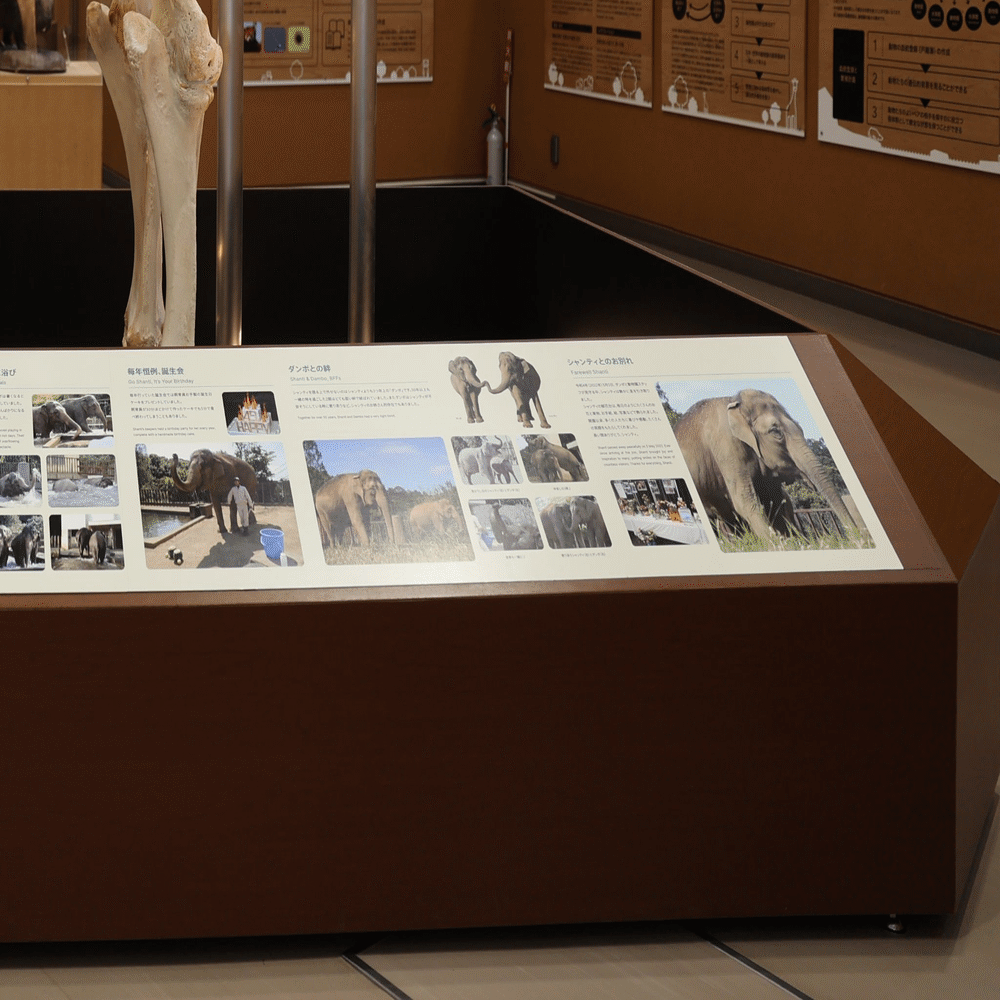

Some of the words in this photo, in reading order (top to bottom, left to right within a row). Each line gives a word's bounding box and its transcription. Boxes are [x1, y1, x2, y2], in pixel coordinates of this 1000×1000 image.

[735, 16, 740, 28] 3
[873, 39, 877, 52] 1
[872, 73, 878, 85] 2
[872, 105, 878, 118] 3
[567, 357, 634, 366] シャンティとのお別れ
[127, 367, 184, 376] 毎年恒例、誕生会
[288, 364, 331, 373] ダンボとの絆
